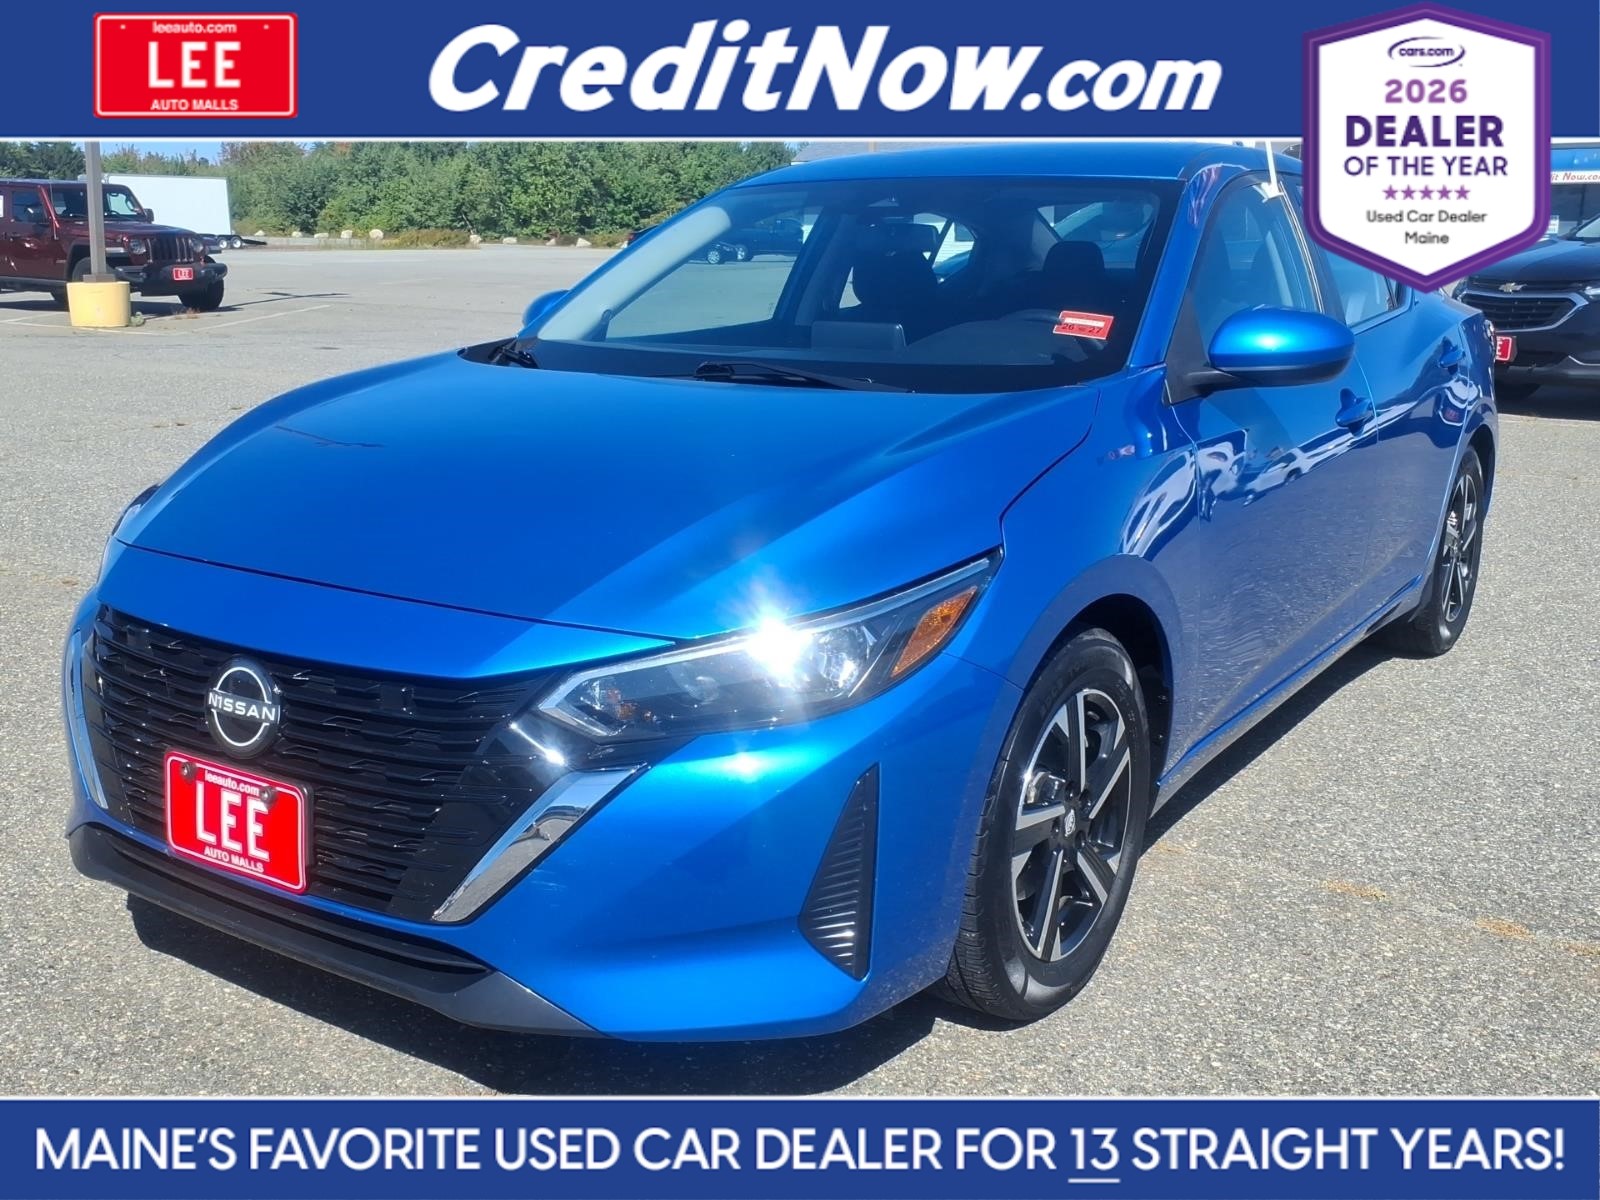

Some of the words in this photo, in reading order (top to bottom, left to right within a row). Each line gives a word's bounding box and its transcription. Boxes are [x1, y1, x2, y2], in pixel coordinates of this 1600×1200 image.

[1562, 172, 1600, 181] Now.co
[208, 691, 276, 721] NISSAN
[204, 769, 260, 795] leeauto.com
[195, 780, 270, 862] LEE
[203, 847, 230, 863] AUTO
[231, 854, 265, 874] MALLS
